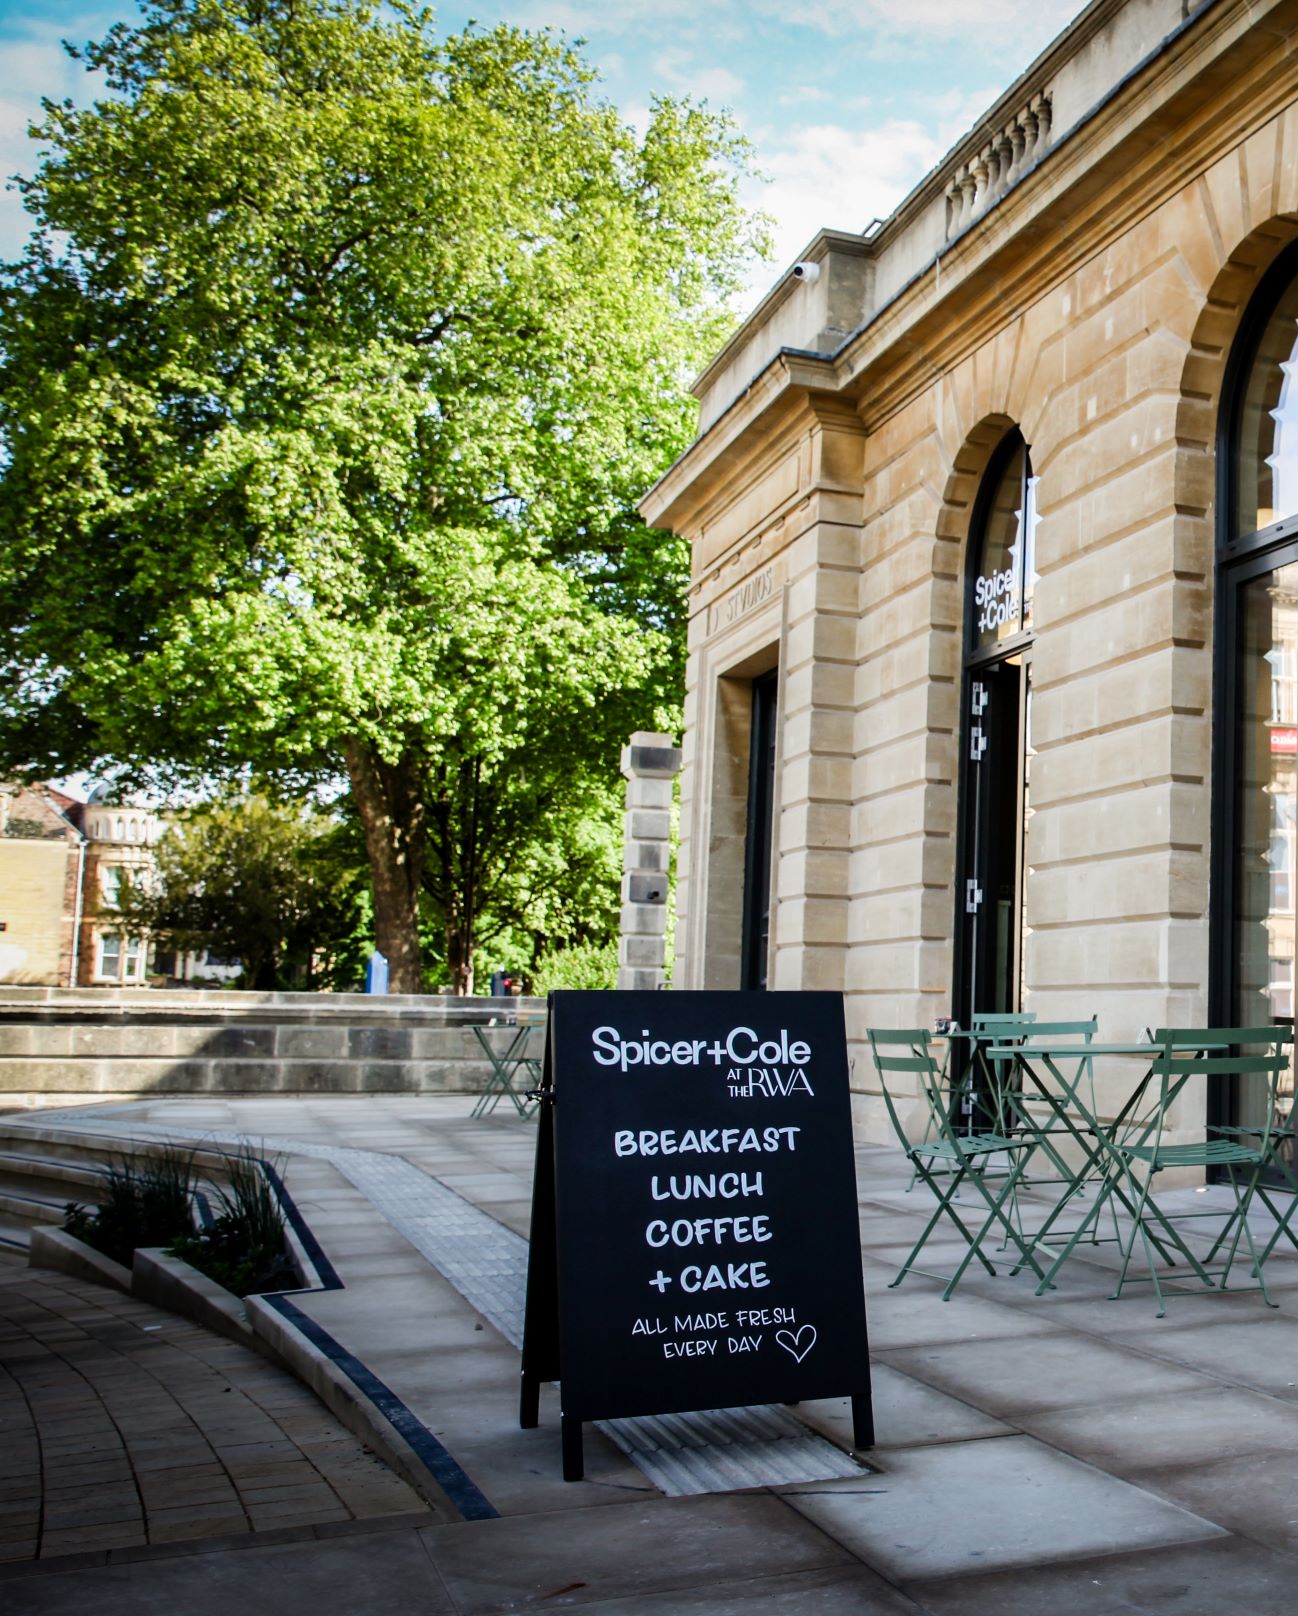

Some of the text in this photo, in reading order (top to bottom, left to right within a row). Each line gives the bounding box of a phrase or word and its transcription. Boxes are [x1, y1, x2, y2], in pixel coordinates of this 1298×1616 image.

[592, 1026, 812, 1072] Spicer+Cole
[727, 1068, 742, 1081] AT
[728, 1067, 815, 1098] THE RWA
[614, 1126, 801, 1157] BREAKFAST
[651, 1171, 764, 1201] LUNCH
[645, 1215, 773, 1248] COFFEE
[649, 1261, 771, 1293] + CAKE
[631, 1307, 796, 1336] ALL MADE FRESH
[663, 1335, 763, 1359] EVERY DAY
